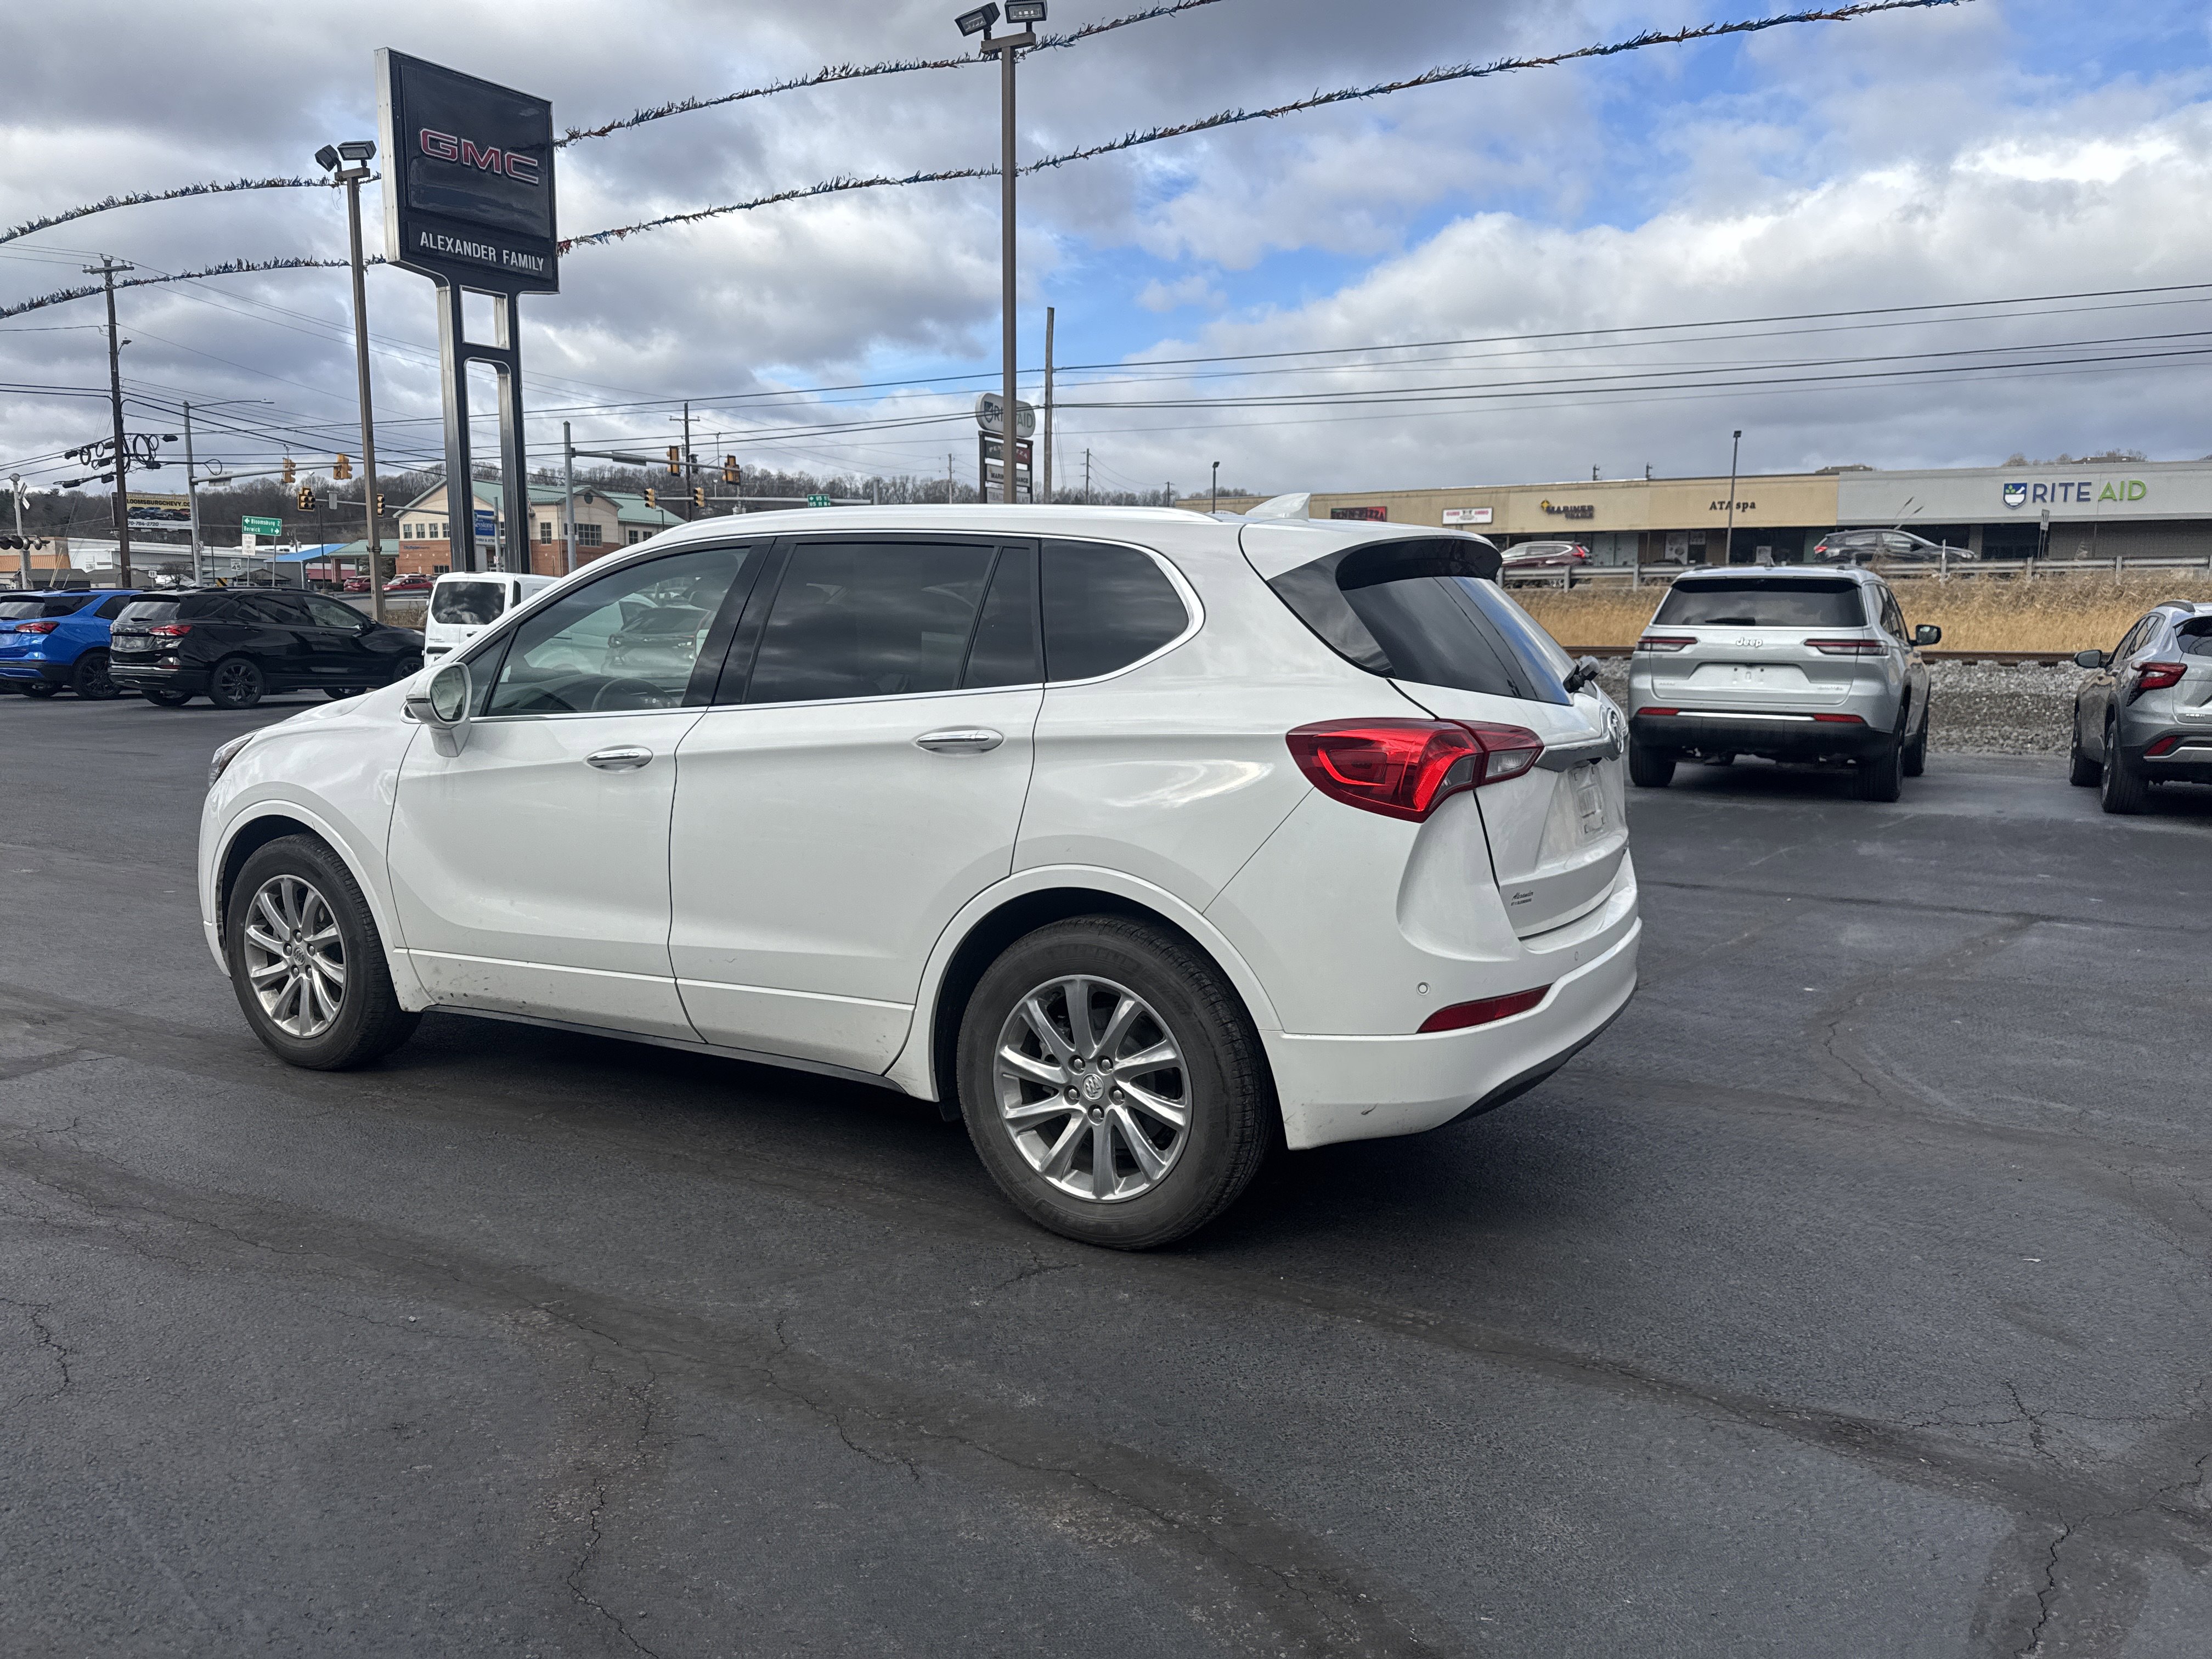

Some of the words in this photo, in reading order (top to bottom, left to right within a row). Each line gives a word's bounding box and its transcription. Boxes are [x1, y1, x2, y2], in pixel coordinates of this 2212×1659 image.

[419, 128, 539, 185] GMC
[420, 231, 496, 263] ALEXANDER
[503, 250, 544, 272] FAMILY
[1017, 412, 1034, 428] AID
[2032, 482, 2092, 503] RITE
[2098, 480, 2147, 501] AID
[127, 499, 190, 507] LOOMSBURGCHEVY.CO
[1736, 501, 1756, 512] spa
[1736, 637, 1763, 647] Jeep
